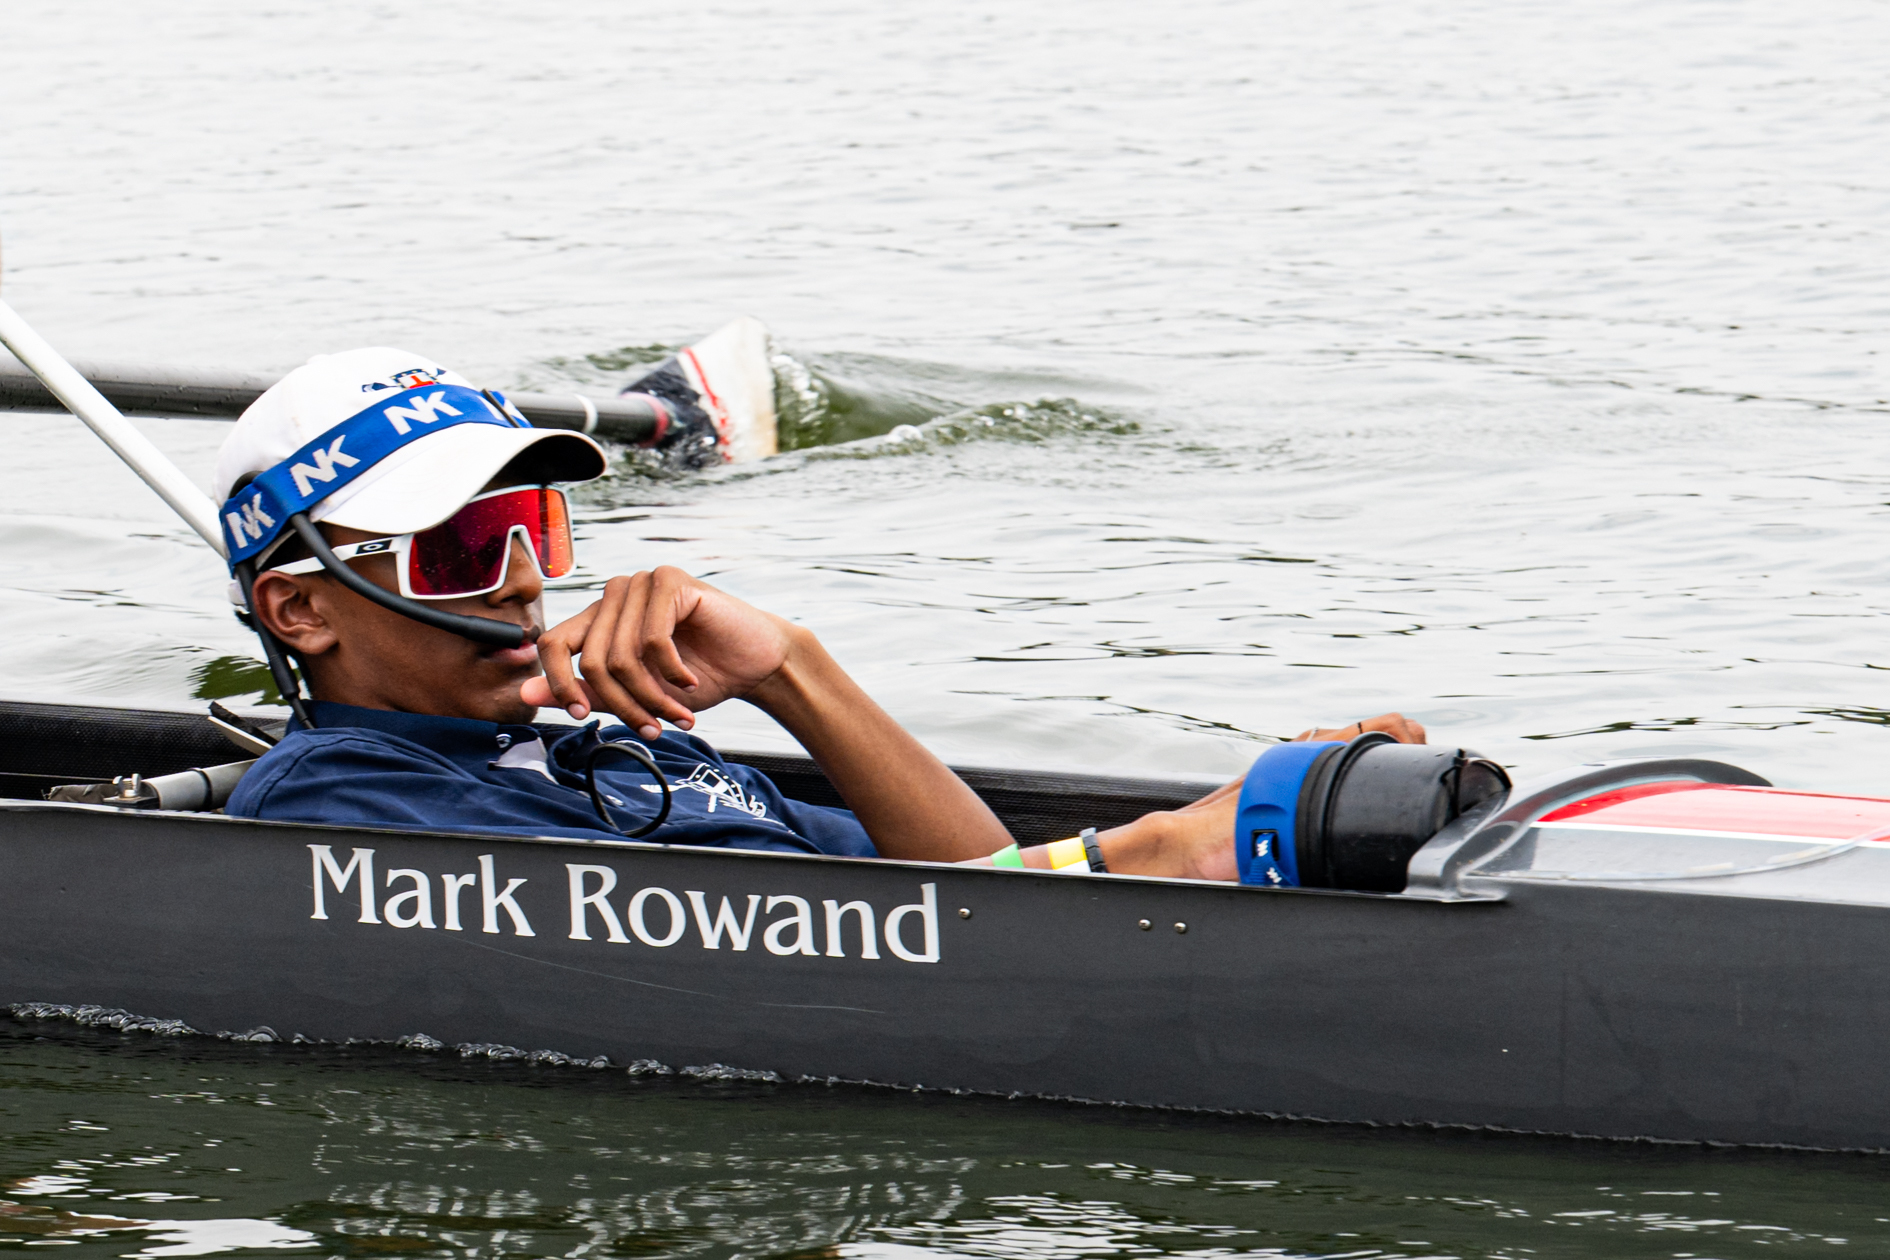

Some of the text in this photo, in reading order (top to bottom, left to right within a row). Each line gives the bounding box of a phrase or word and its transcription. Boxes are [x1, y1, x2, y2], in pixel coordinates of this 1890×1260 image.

[383, 391, 464, 435] NK
[289, 434, 361, 497] NK
[225, 491, 276, 549] NK
[307, 844, 941, 963] Mark Rowand
